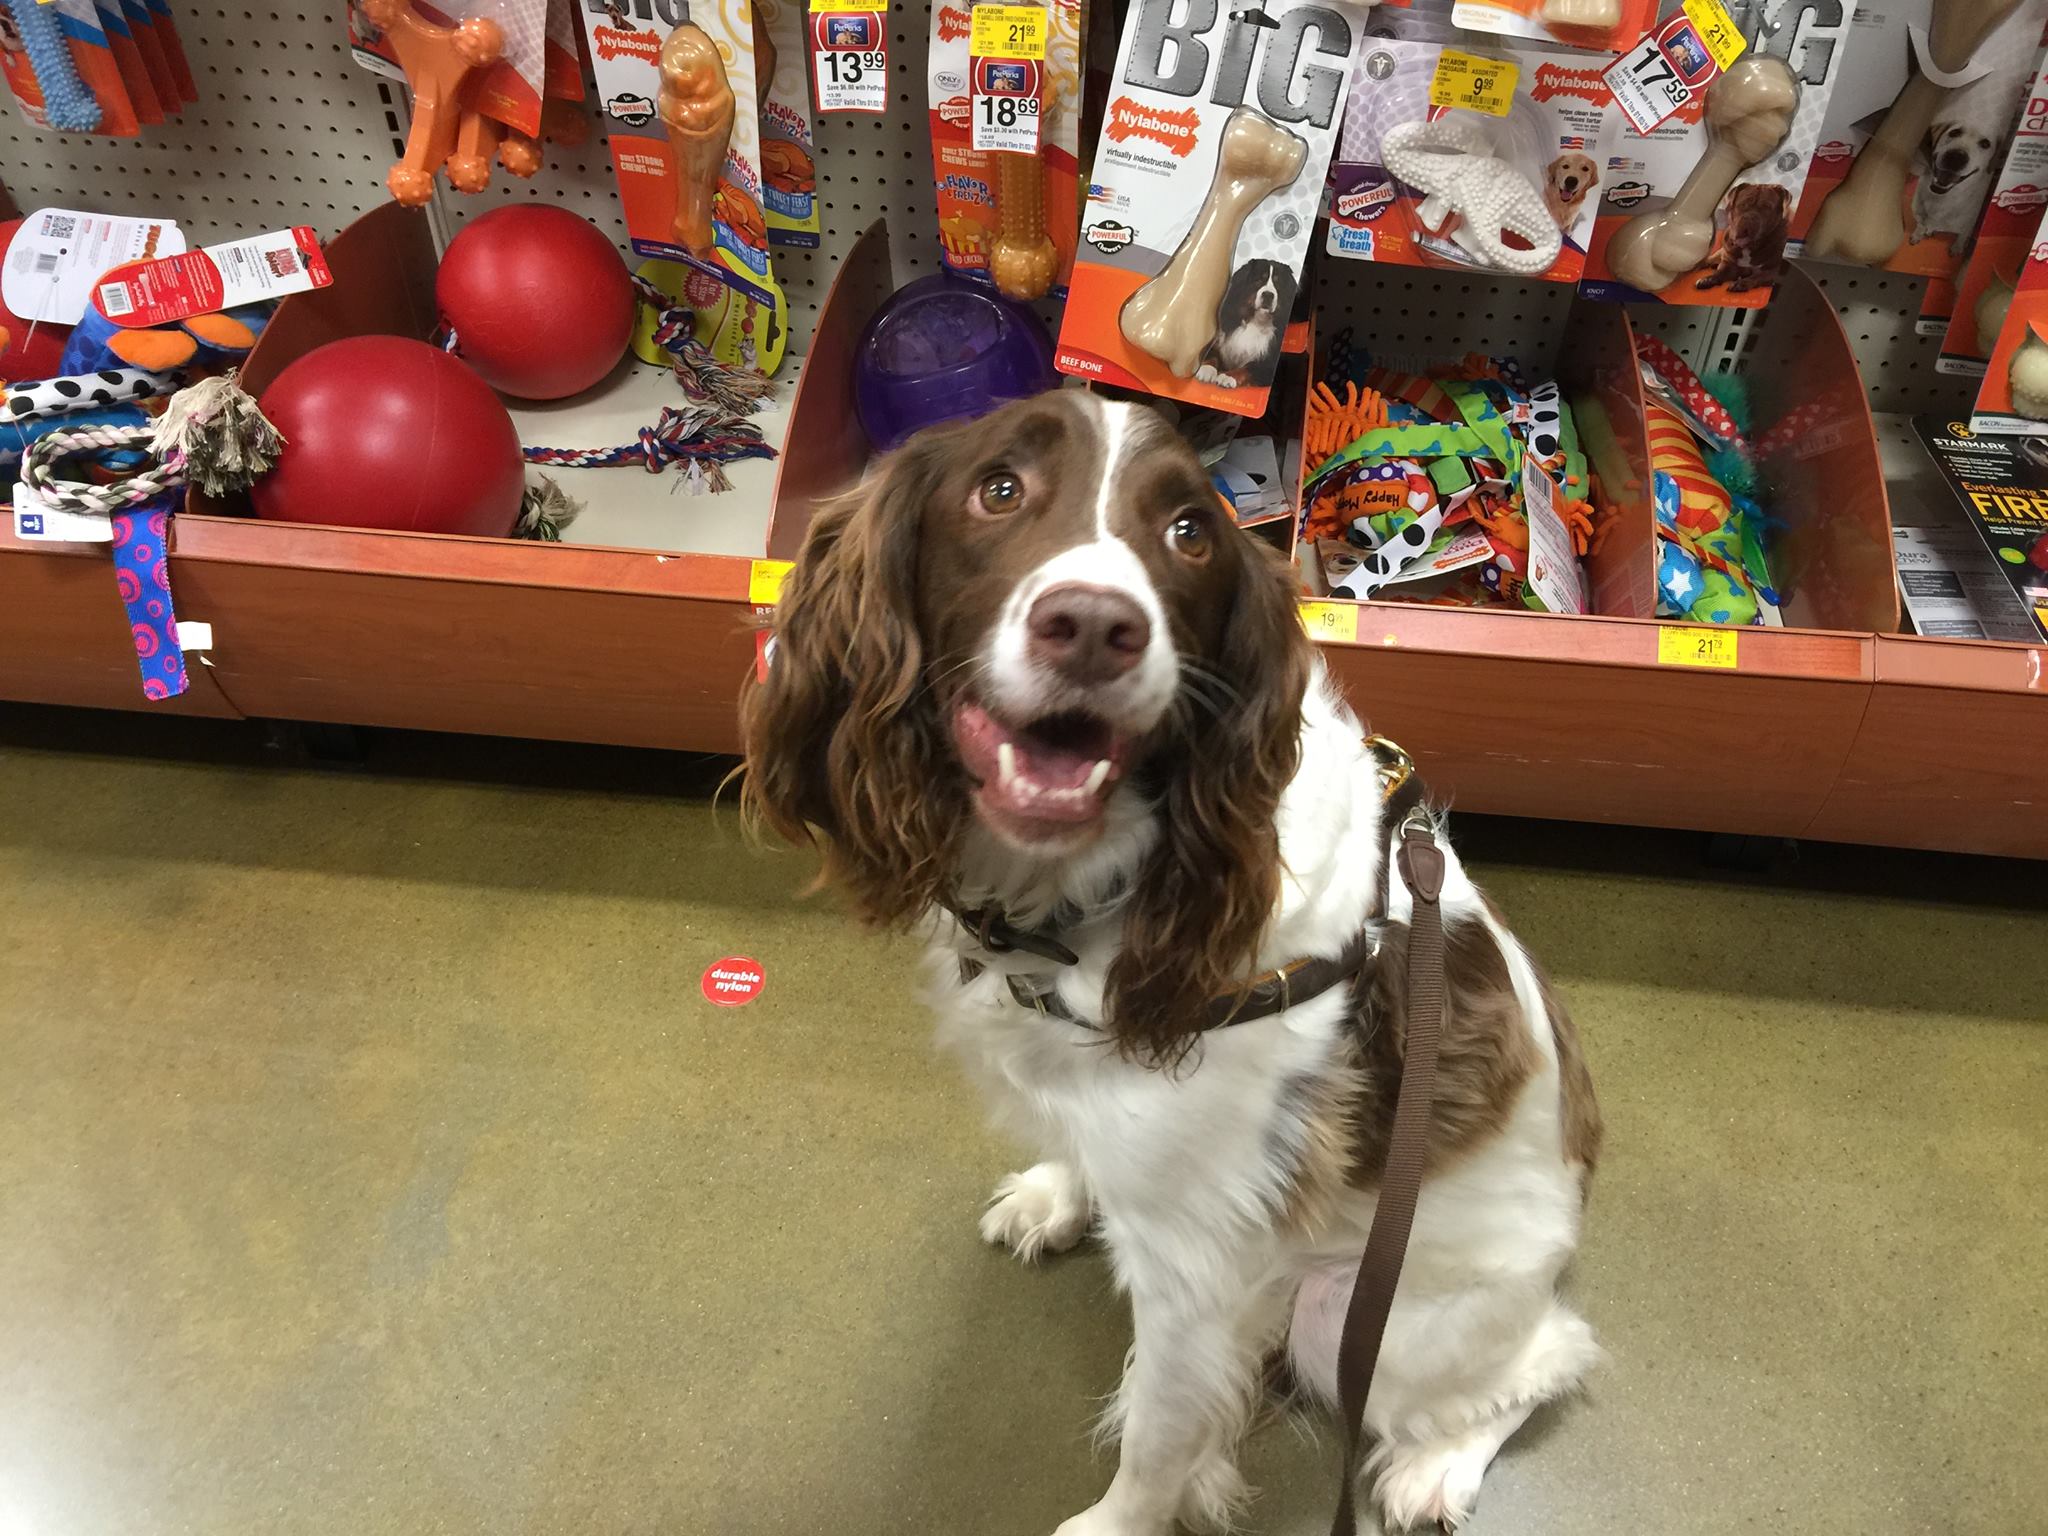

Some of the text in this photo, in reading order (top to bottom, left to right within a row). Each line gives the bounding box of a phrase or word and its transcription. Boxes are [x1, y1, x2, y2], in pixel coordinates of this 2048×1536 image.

[834, 23, 862, 32] PetPerks
[944, 17, 971, 31] Nyla
[601, 35, 658, 53] Nylabone
[1440, 58, 1467, 67] NYLABONE
[937, 75, 957, 83] ONLY
[992, 70, 1019, 79] PetPerks
[613, 104, 649, 113] POWERFUL
[768, 102, 806, 132] FLAVOR
[1118, 108, 1190, 137] Nylabone
[1106, 148, 1178, 171] virtually indestructible
[946, 175, 988, 194] FLAVOR
[953, 189, 987, 206] FRENZY
[1341, 186, 1393, 210] POWERFUL
[1354, 205, 1386, 221] Chewers
[1092, 230, 1127, 241] POWERFUL
[1343, 228, 1370, 240] Fresh
[1097, 242, 1122, 253] Chewers
[1340, 238, 1371, 252] Breath
[1060, 355, 1080, 368] BEEF
[1080, 360, 1103, 374] BONE
[1944, 362, 1966, 370] BACON
[1933, 437, 2010, 452] STARMARK
[1961, 481, 2040, 499] Everlasting
[1362, 490, 1400, 507] Happy
[1982, 516, 2007, 524] Helps
[2008, 517, 2037, 526] Prevent
[711, 968, 760, 984] durable
[715, 981, 752, 993] nylon
